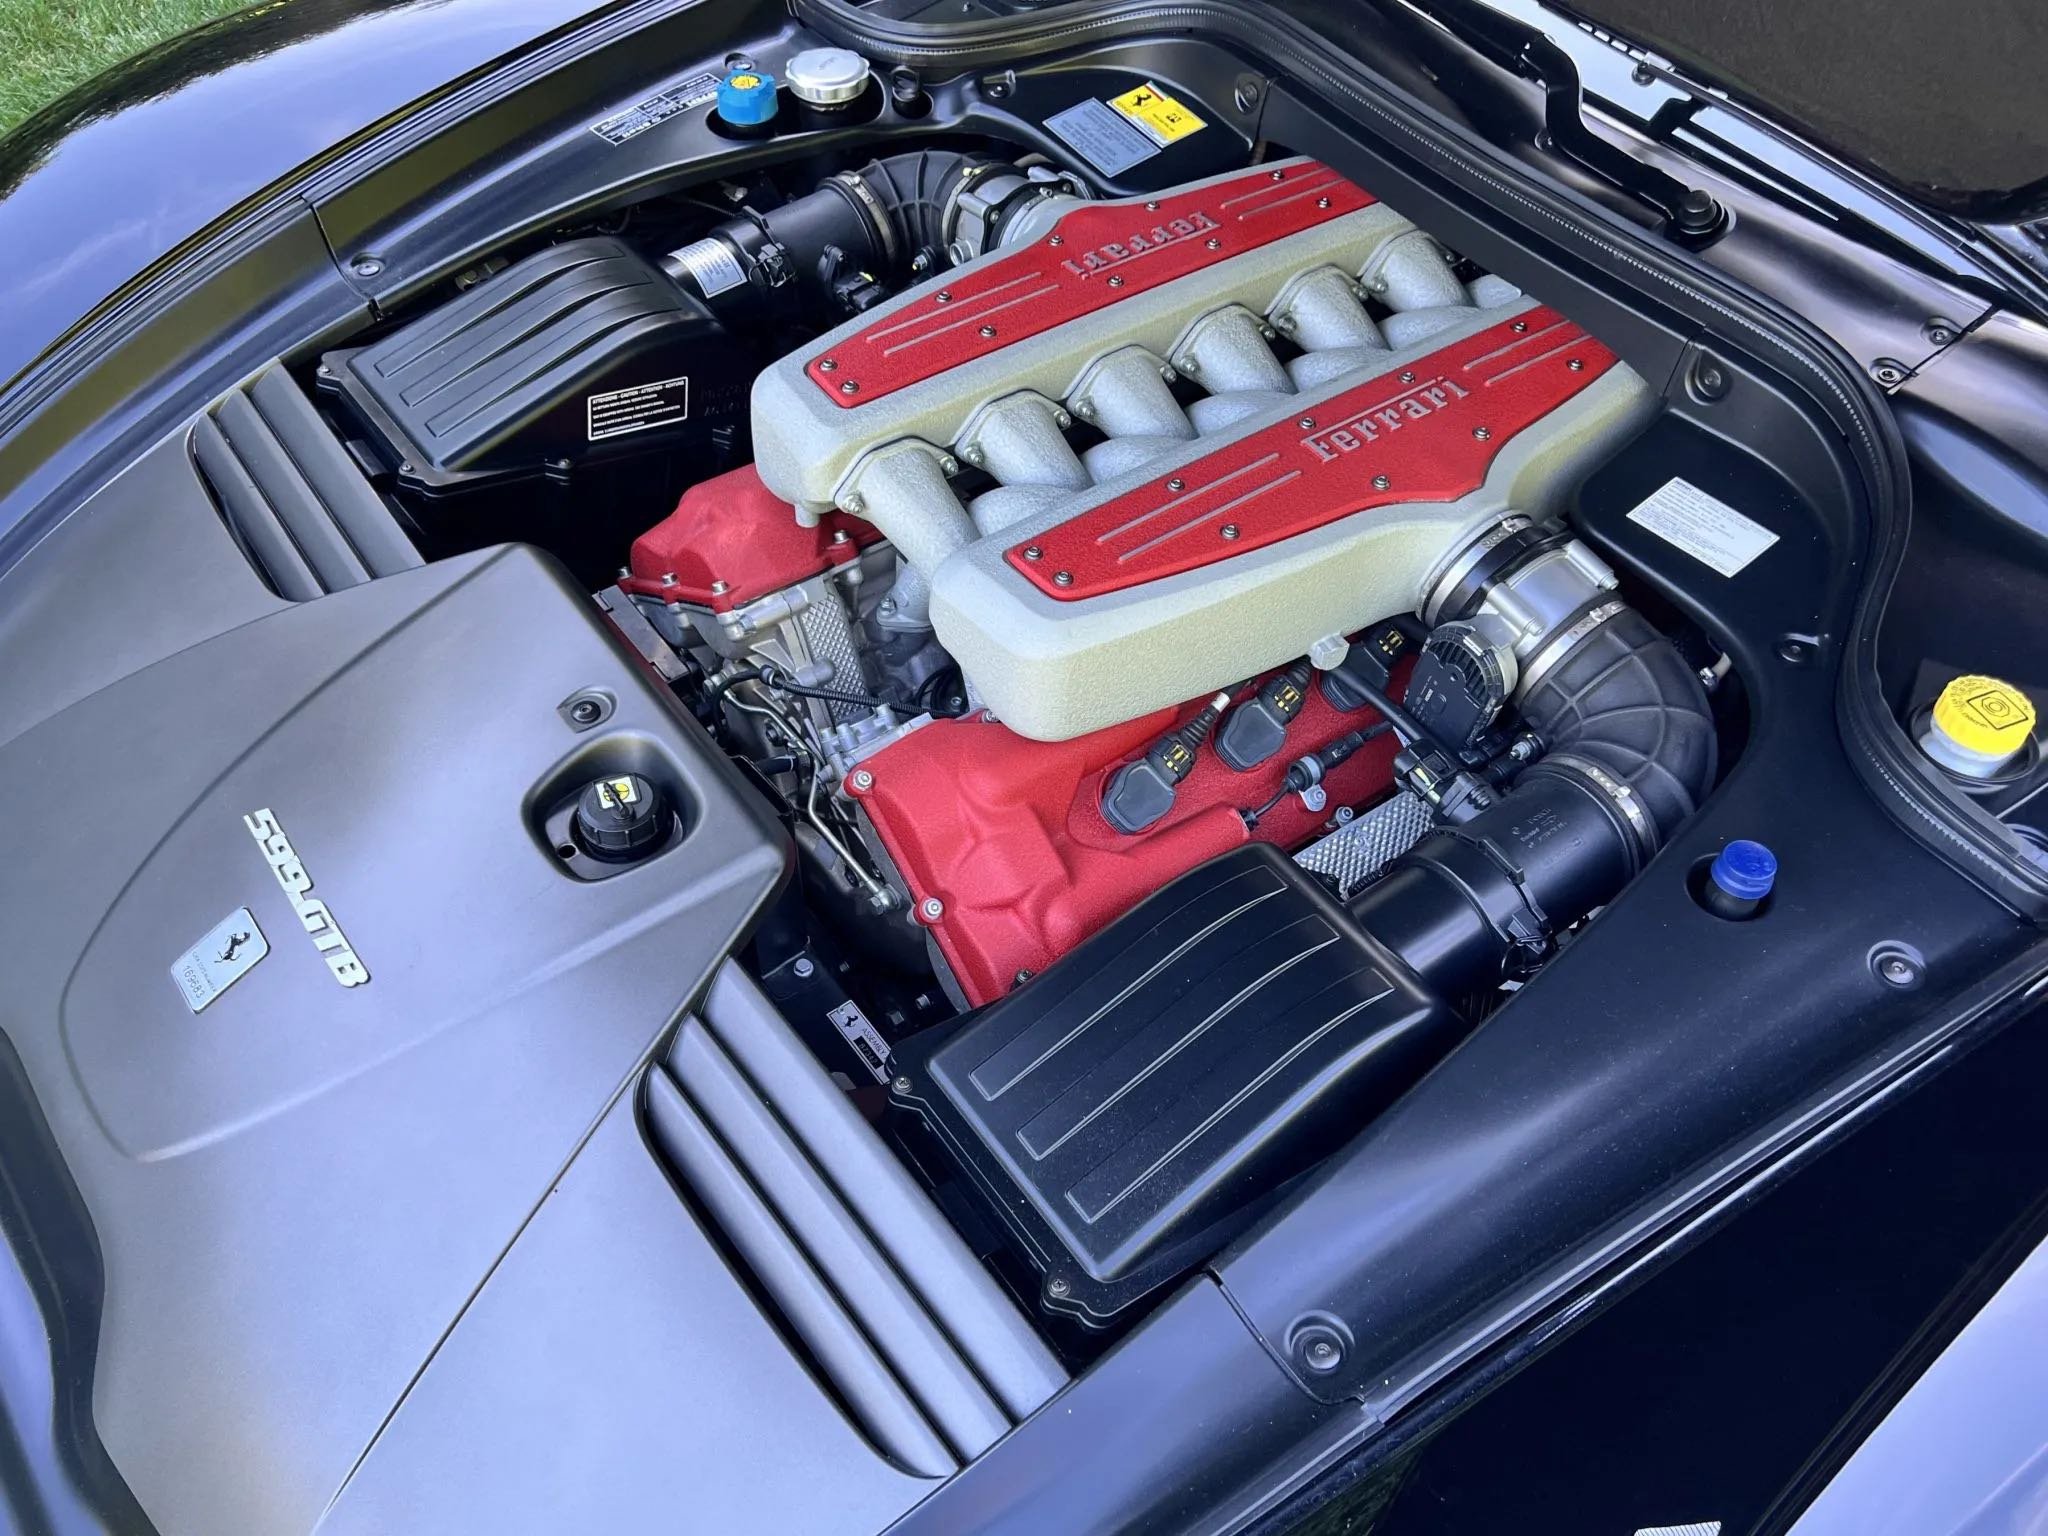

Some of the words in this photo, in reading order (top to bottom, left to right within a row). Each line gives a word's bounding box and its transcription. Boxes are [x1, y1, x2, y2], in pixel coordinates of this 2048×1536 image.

[1060, 211, 1222, 280] Ferrari
[1300, 376, 1470, 464] Ferrari
[862, 1028, 886, 1054] ASSEMBLY
